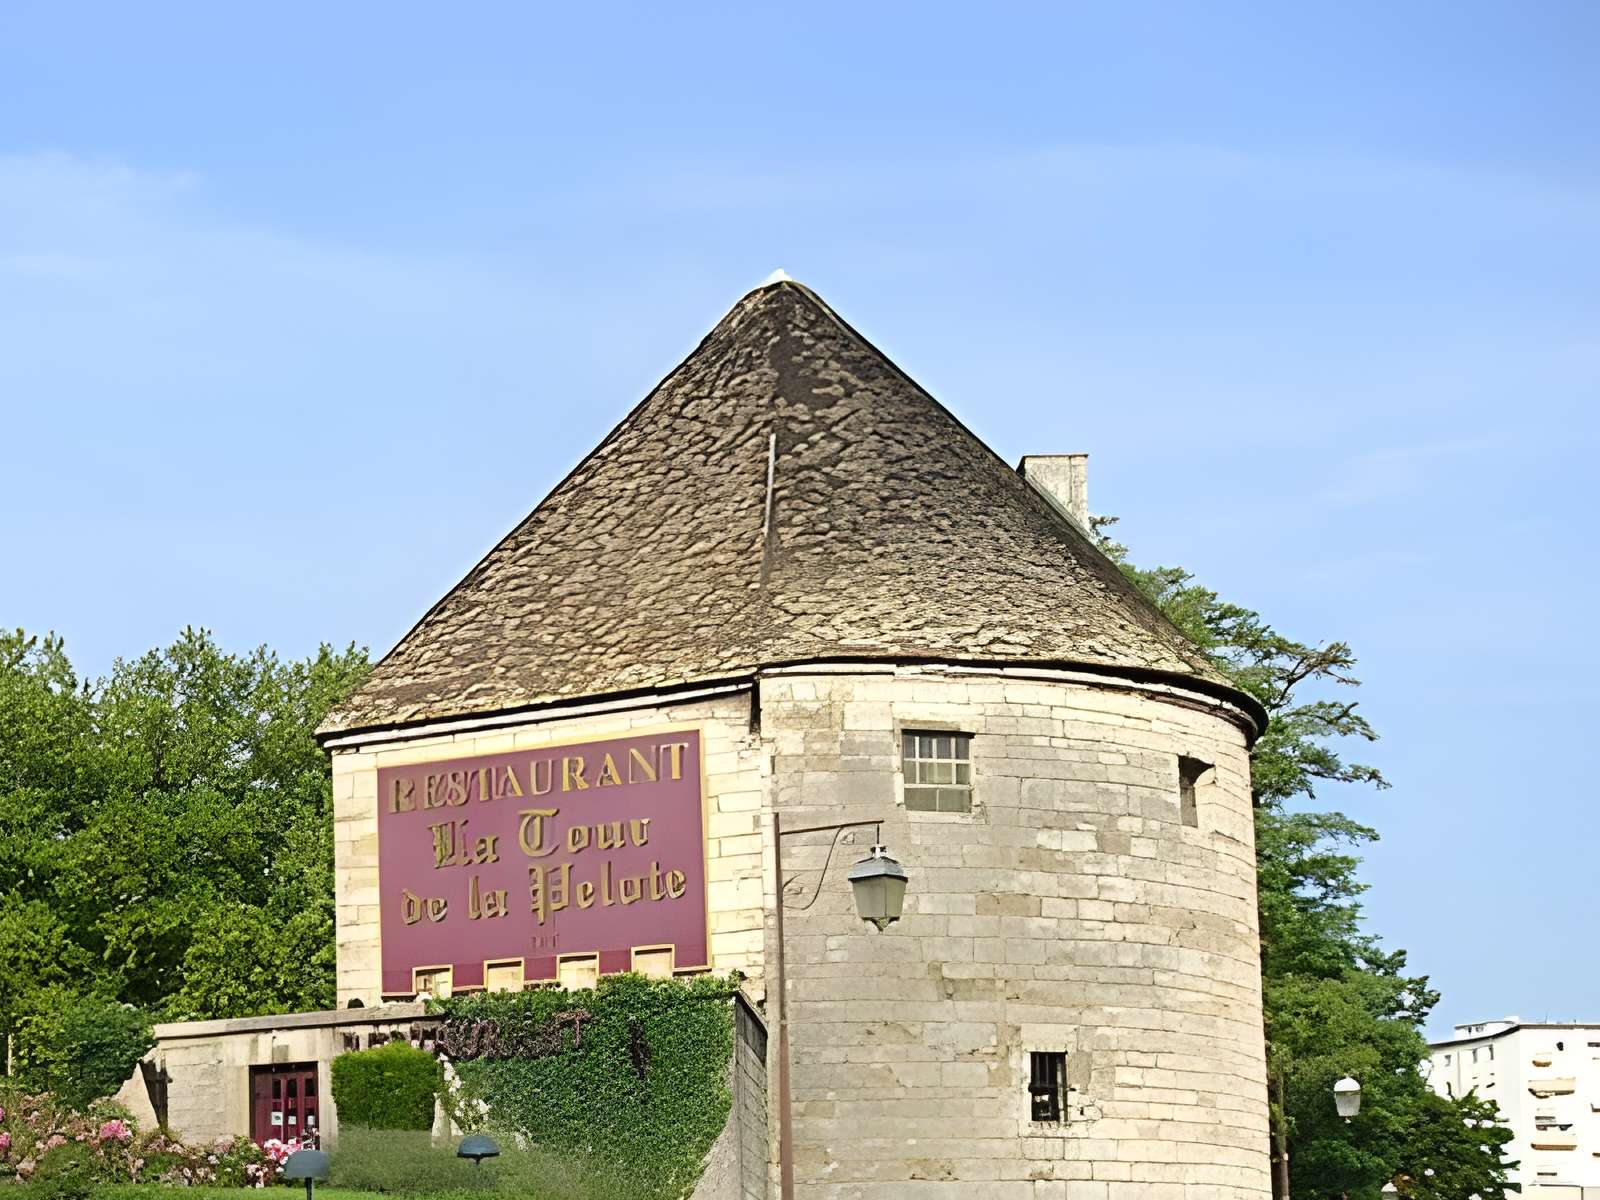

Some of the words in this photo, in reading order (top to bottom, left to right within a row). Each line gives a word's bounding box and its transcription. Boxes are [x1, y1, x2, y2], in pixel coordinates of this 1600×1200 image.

[389, 742, 690, 814] RESTAURANT
[428, 819, 500, 869] La
[517, 808, 651, 857] Tour
[401, 888, 448, 926] de
[468, 875, 509, 920] la
[528, 861, 687, 926] Pelote
